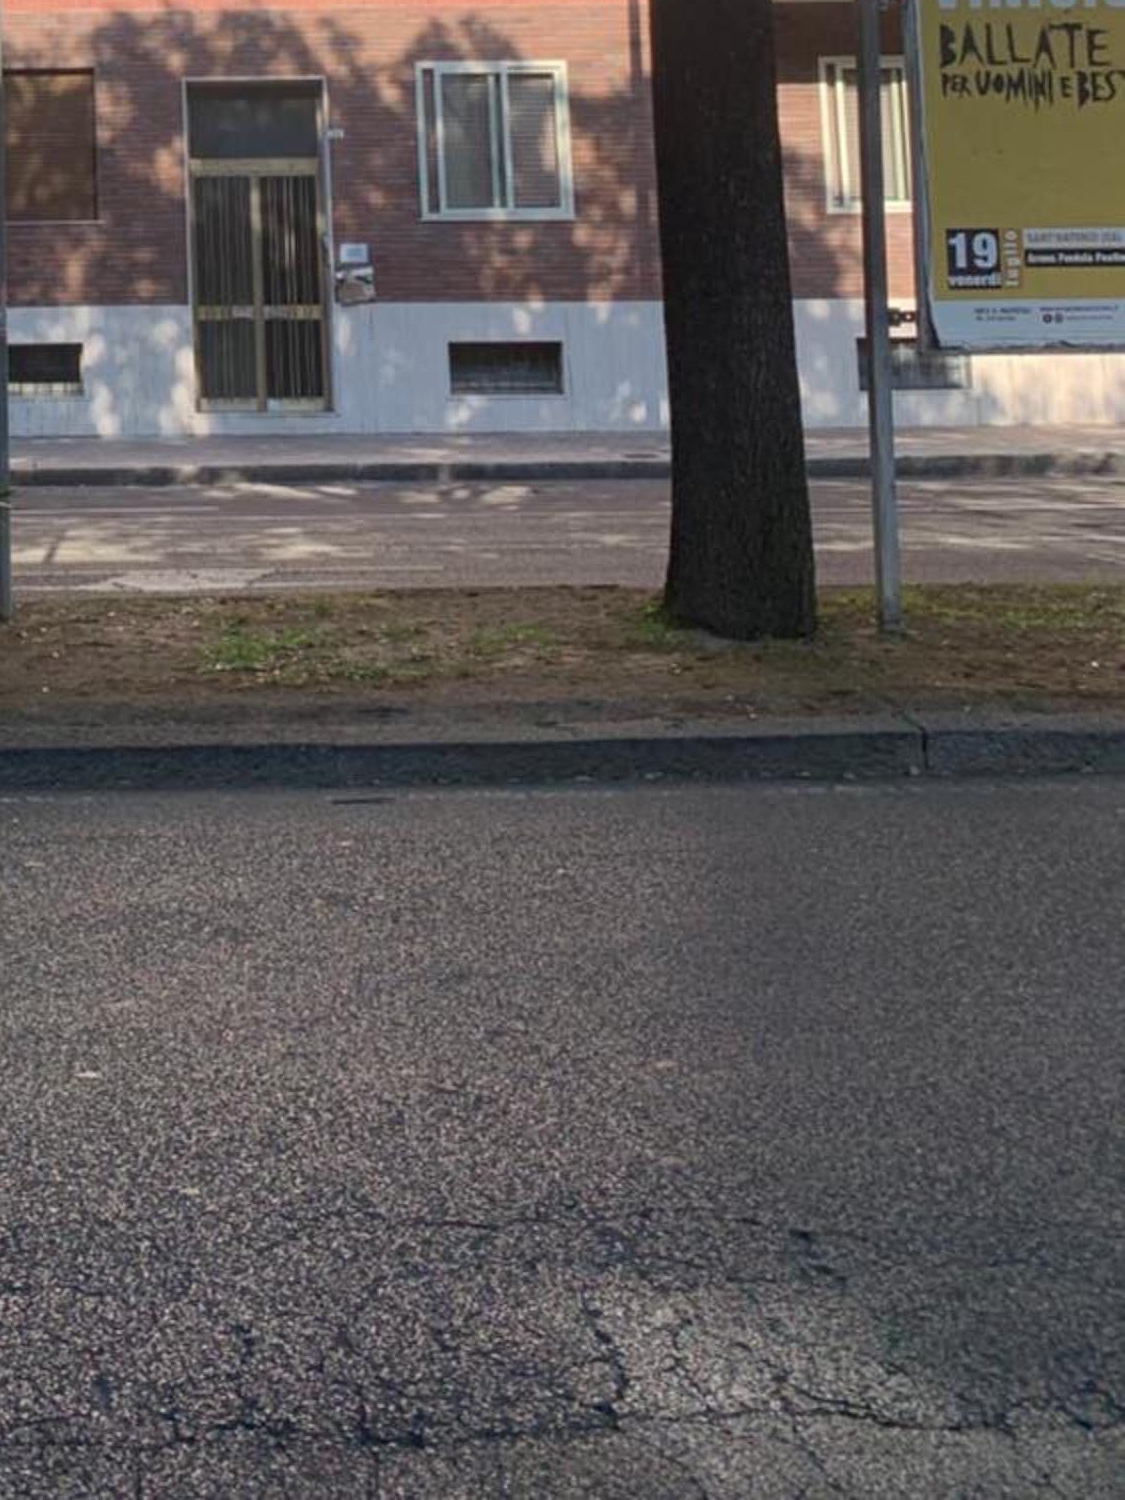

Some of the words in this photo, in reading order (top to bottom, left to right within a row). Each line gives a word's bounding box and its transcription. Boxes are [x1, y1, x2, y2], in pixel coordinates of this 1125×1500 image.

[940, 21, 1111, 69] BALLATE
[941, 72, 972, 98] PER
[975, 67, 1054, 107] UOMINI
[1060, 76, 1072, 98] E
[948, 231, 998, 269] 19
